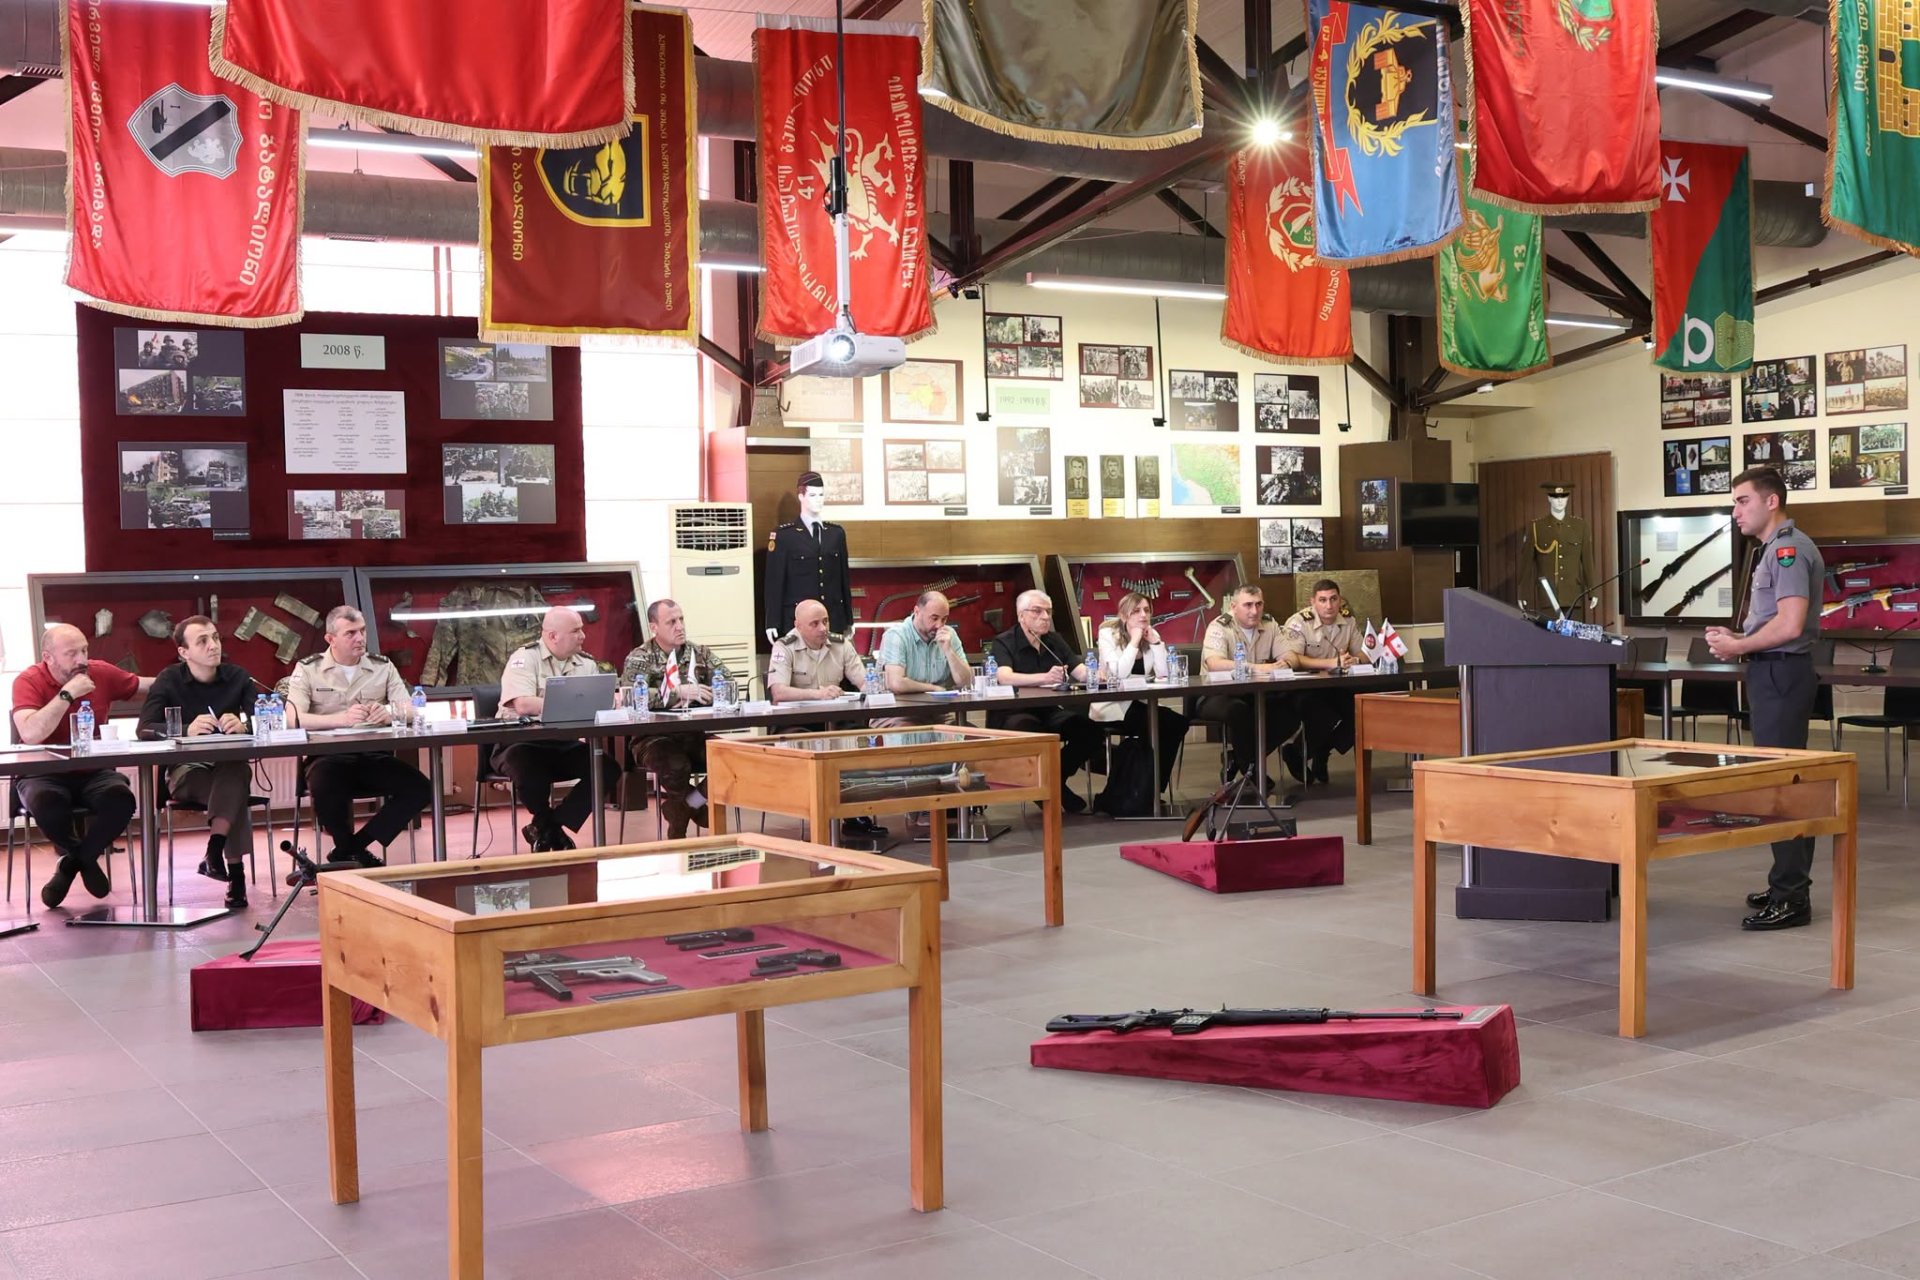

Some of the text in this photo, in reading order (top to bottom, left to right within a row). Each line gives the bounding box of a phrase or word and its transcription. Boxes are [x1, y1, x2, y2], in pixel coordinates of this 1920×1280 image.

[796, 175, 816, 201] 41
[239, 133, 276, 286] ბატალიონი
[511, 162, 525, 261] ბატალიონი
[1513, 244, 1527, 272] 13
[1319, 269, 1341, 321] ალიონი
[322, 344, 351, 356] 2008
